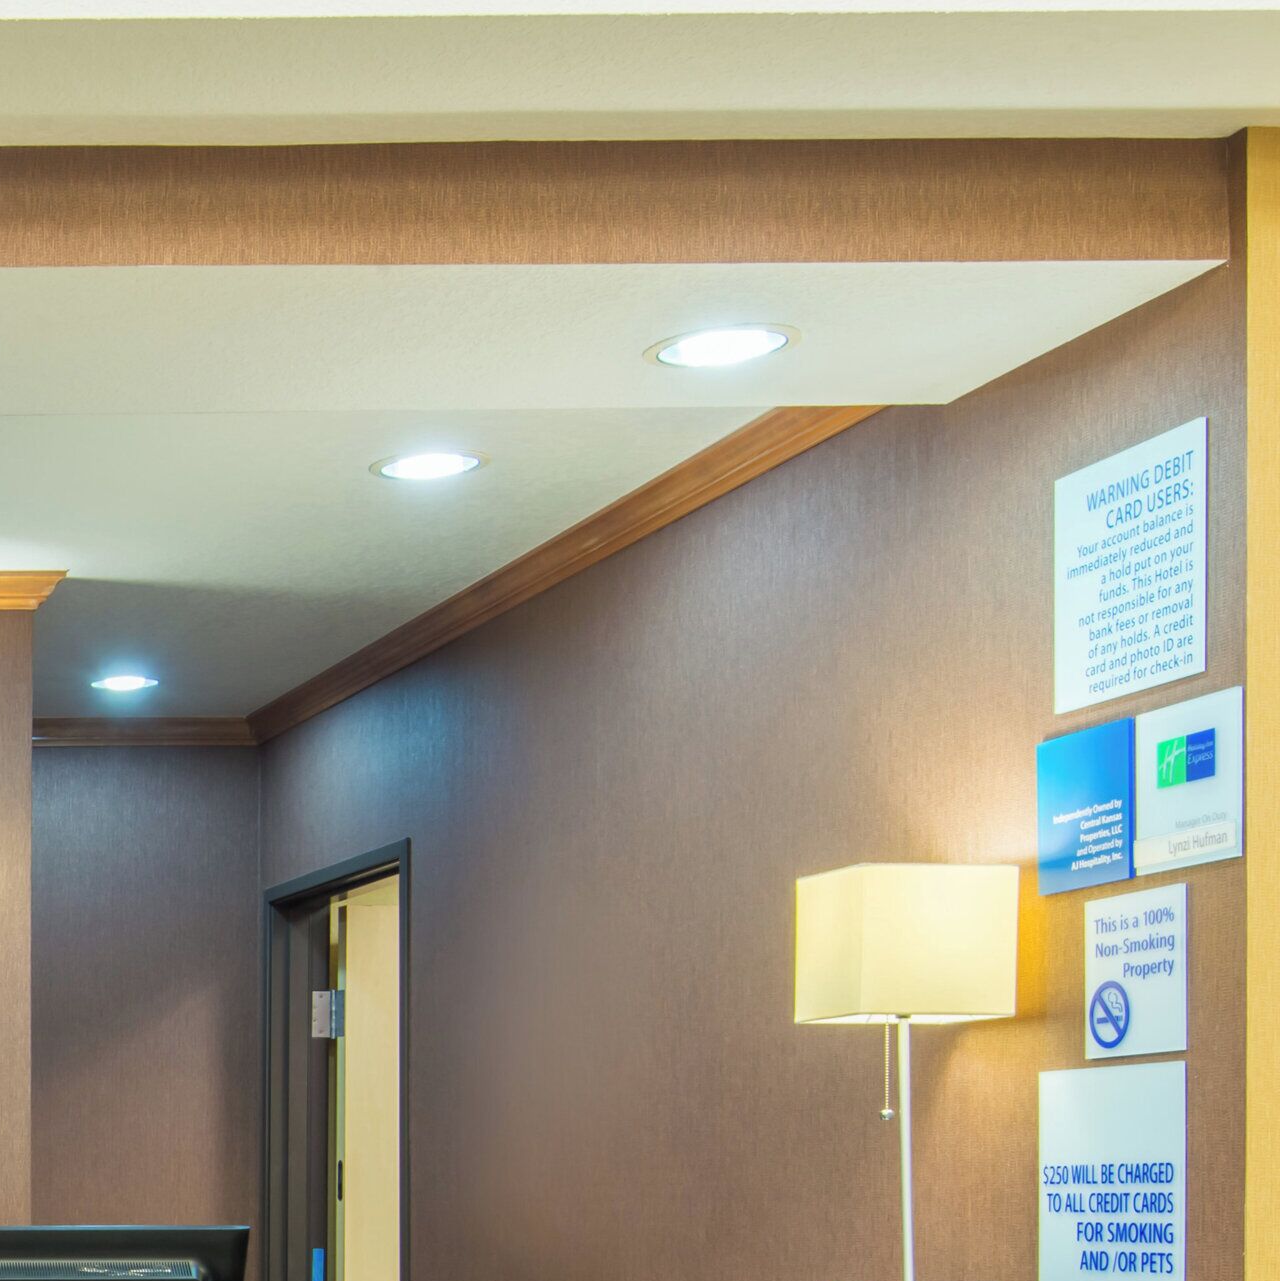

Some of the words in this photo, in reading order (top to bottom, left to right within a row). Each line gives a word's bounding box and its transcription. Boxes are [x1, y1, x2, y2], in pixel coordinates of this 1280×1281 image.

[1086, 470, 1150, 512] WARNING
[1154, 450, 1194, 484] DEBIT
[1106, 499, 1142, 528] CARD
[1147, 478, 1194, 512] USERS:
[1067, 547, 1127, 580] immediately
[1130, 528, 1171, 556] reduced
[1174, 519, 1194, 539] and
[1077, 542, 1099, 558] Your
[1101, 525, 1140, 550] account
[1143, 508, 1183, 534] balance
[1186, 503, 1194, 516] is
[1099, 583, 1129, 602] funds.
[1132, 573, 1152, 590] This
[1155, 560, 1183, 582] Hotel
[1186, 558, 1194, 572] is
[1101, 575, 1107, 585] a
[1109, 562, 1132, 582] hold
[1134, 556, 1152, 576] put
[1154, 551, 1167, 565] on
[1170, 541, 1194, 562] your
[1079, 613, 1095, 627] not
[1097, 590, 1155, 621] responsible
[1157, 585, 1172, 600] for
[1175, 578, 1194, 593] any
[1089, 623, 1113, 642] bank
[1116, 615, 1136, 632] fees
[1138, 612, 1149, 625] or
[1151, 594, 1193, 620] removal
[1085, 660, 1106, 677] card
[1109, 652, 1128, 670] and
[1130, 644, 1160, 668] photo
[1163, 637, 1174, 653] ID
[1177, 634, 1194, 649] are
[1088, 644, 1098, 659] of
[1100, 640, 1118, 656] any
[1120, 629, 1151, 649] holds.
[1154, 624, 1161, 638] A
[1163, 613, 1194, 635] credit
[1088, 669, 1131, 694] required
[1133, 666, 1147, 680] for
[1150, 652, 1193, 675] check-in
[1187, 750, 1214, 765] Express
[1080, 816, 1101, 830] Central
[1101, 812, 1123, 825] Kansas
[1111, 824, 1123, 835] LLC
[1094, 917, 1117, 935] This
[1120, 914, 1129, 930] is
[1132, 916, 1139, 929] a
[1143, 905, 1175, 926] 100%
[1095, 932, 1176, 959] Non-Smoking
[1123, 958, 1175, 980] Property
[1043, 1164, 1069, 1186] $250
[1071, 1164, 1098, 1185] WILL
[1101, 1163, 1115, 1184] BE
[1117, 1162, 1175, 1184] CHARGED
[1047, 1192, 1062, 1213] TO
[1064, 1192, 1086, 1213] ALL
[1088, 1192, 1130, 1213] CREDIT
[1133, 1192, 1174, 1214] CARDS
[1076, 1222, 1104, 1242] FOR
[1107, 1222, 1174, 1244] SMOKING
[1079, 1250, 1110, 1271] AND
[1113, 1251, 1137, 1273] /OR
[1141, 1252, 1174, 1274] PETS
